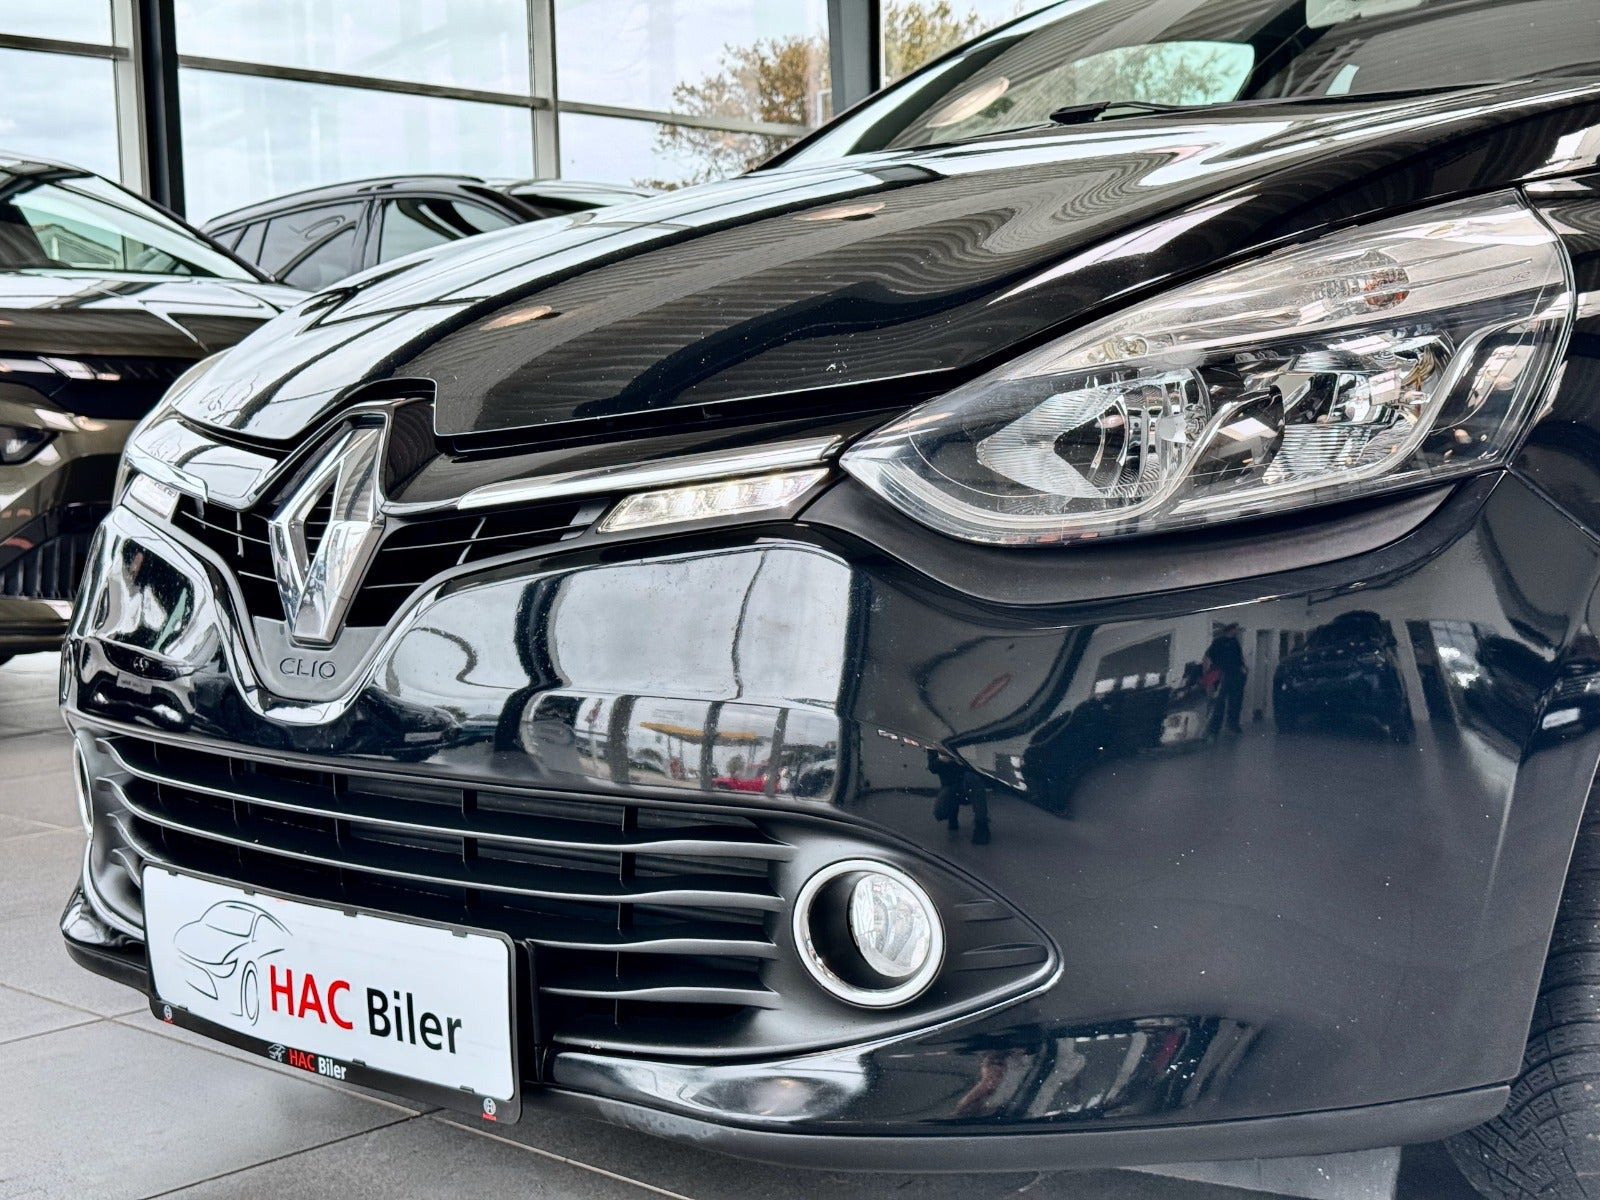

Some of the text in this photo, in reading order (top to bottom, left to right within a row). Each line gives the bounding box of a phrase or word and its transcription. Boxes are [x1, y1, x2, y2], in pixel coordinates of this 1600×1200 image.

[280, 657, 336, 679] CLIO
[270, 964, 462, 1054] HAC Biler
[288, 1048, 347, 1080] HAC Biler
